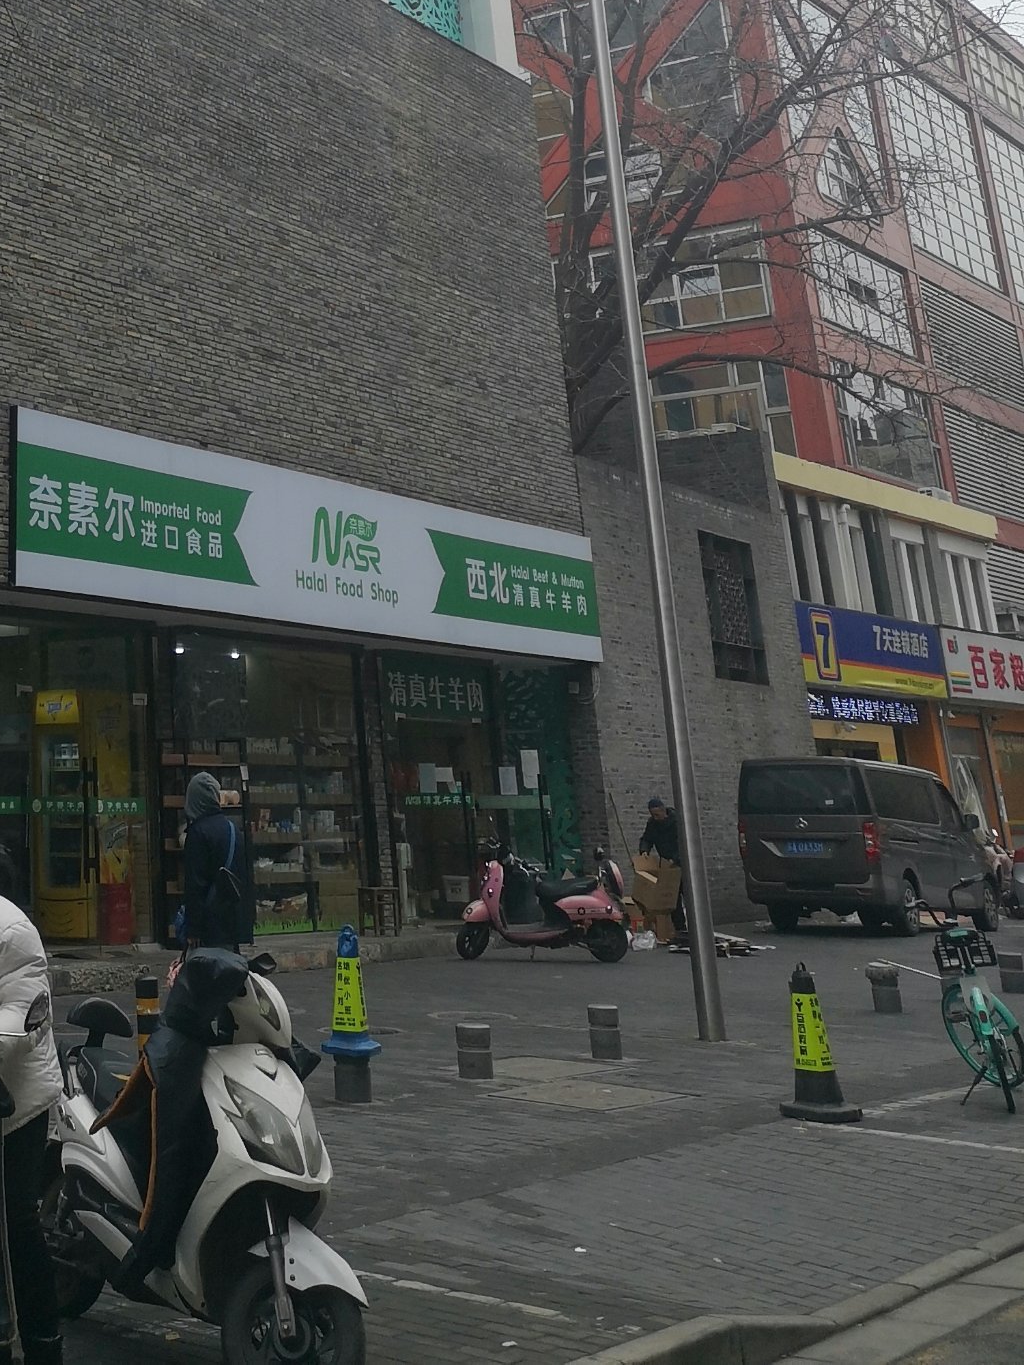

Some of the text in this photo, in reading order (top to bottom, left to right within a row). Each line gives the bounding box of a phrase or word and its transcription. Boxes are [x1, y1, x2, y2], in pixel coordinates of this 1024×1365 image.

[29, 474, 136, 542] 奈素尔
[140, 495, 222, 526] Imported Food
[140, 520, 223, 559] 进口食品
[311, 506, 382, 575] NASR
[295, 569, 399, 608] Halal Food Shop
[465, 557, 510, 604] 西北
[510, 564, 585, 590] Halal Beef & Mutton
[512, 582, 588, 616] 清真牛羊肉
[814, 620, 831, 670] 7
[872, 624, 929, 659] 7天连锁酒店
[387, 671, 484, 712] 清真牛羊肉
